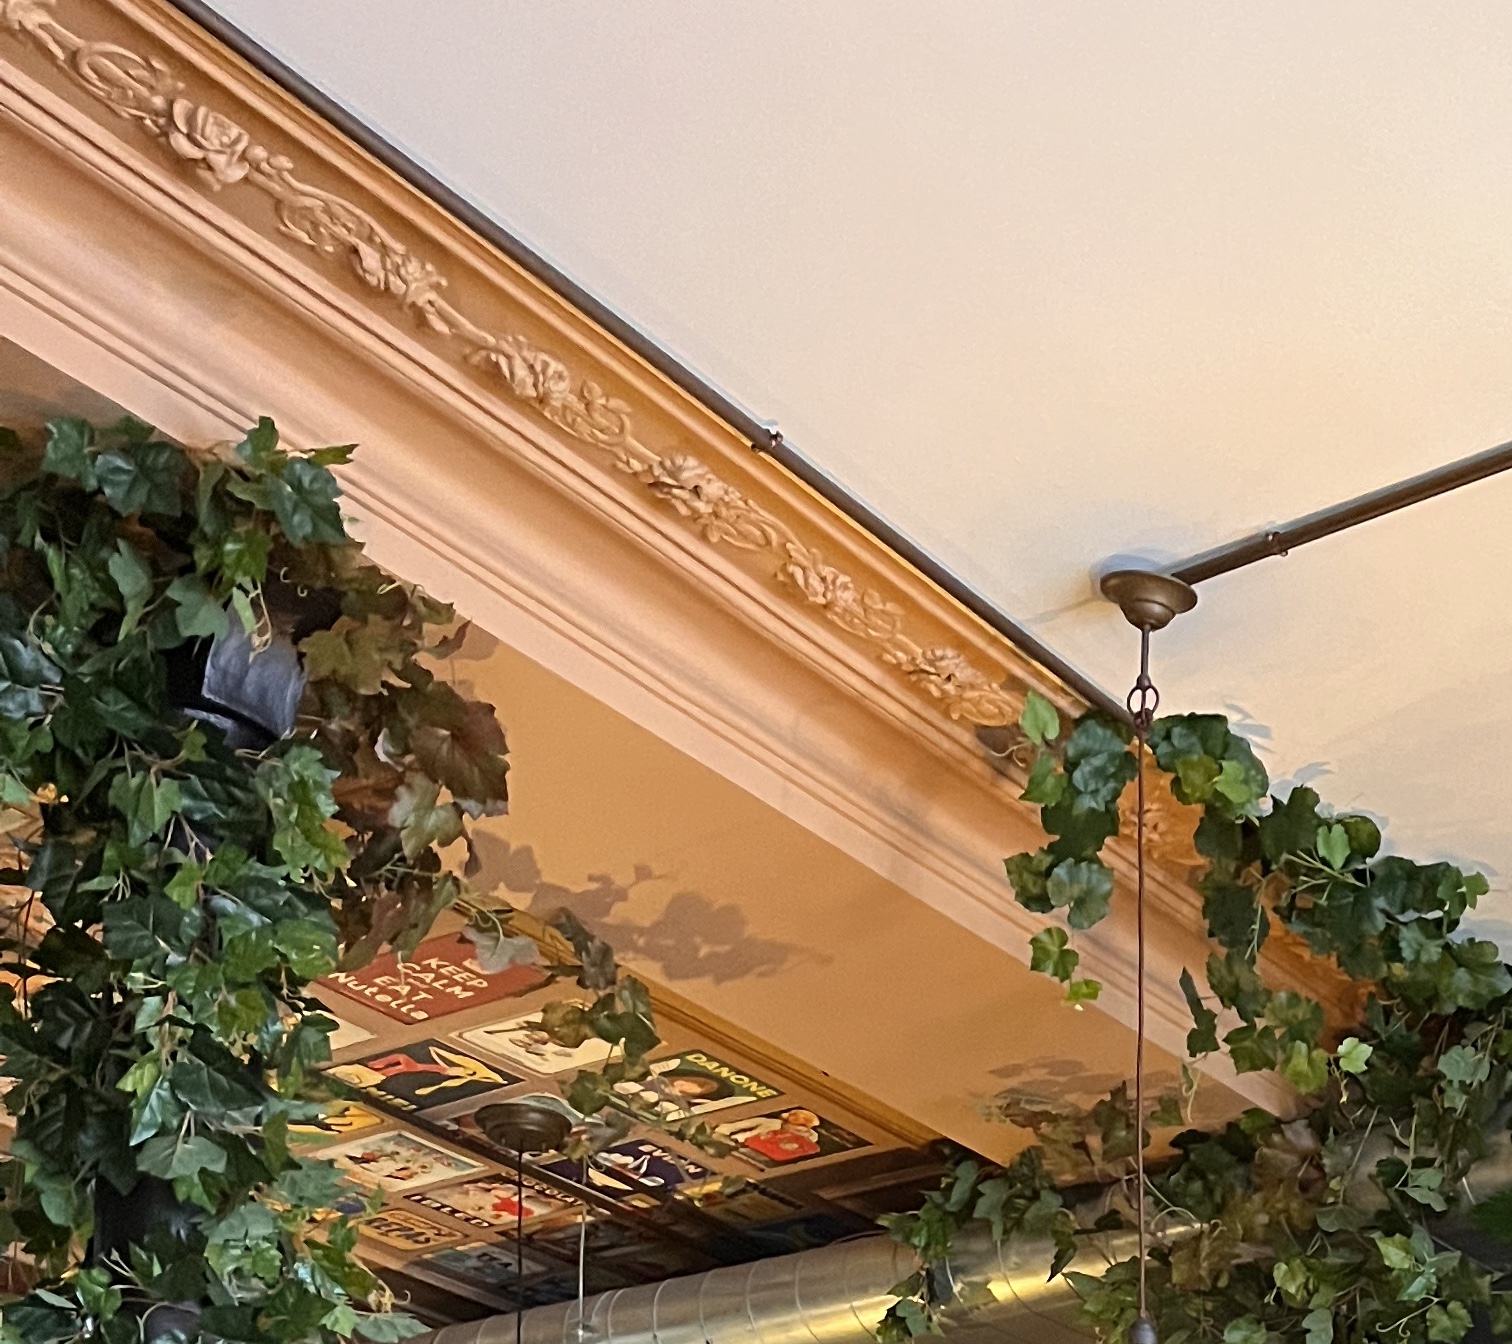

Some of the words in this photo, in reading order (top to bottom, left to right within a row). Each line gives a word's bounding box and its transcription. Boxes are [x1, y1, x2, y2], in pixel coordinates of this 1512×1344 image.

[373, 975, 434, 1002] EAT
[397, 962, 475, 999] CALM
[422, 957, 488, 989] KEEP
[686, 1053, 778, 1099] DANONE
